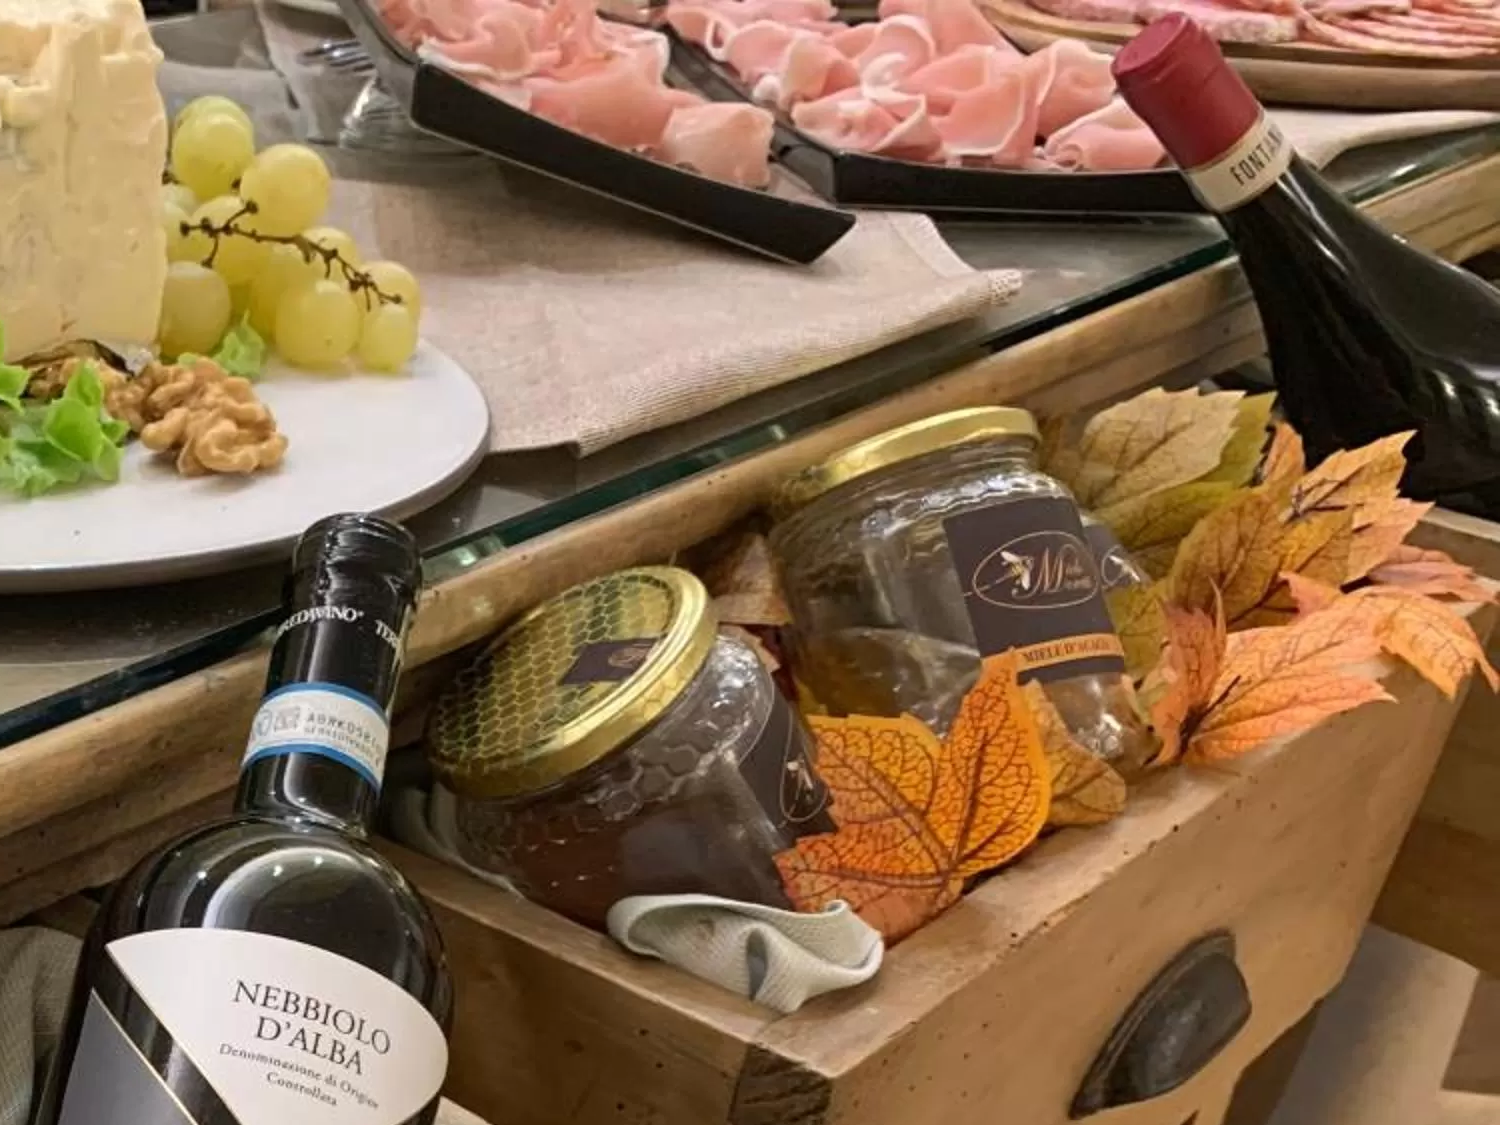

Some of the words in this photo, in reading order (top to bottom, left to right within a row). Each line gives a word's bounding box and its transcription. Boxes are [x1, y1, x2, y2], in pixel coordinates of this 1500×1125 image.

[233, 979, 392, 1055] NEBBIOLO
[219, 1042, 322, 1081] Denominazione
[255, 1015, 363, 1075] D'ALBA
[266, 1071, 338, 1107] Controllata
